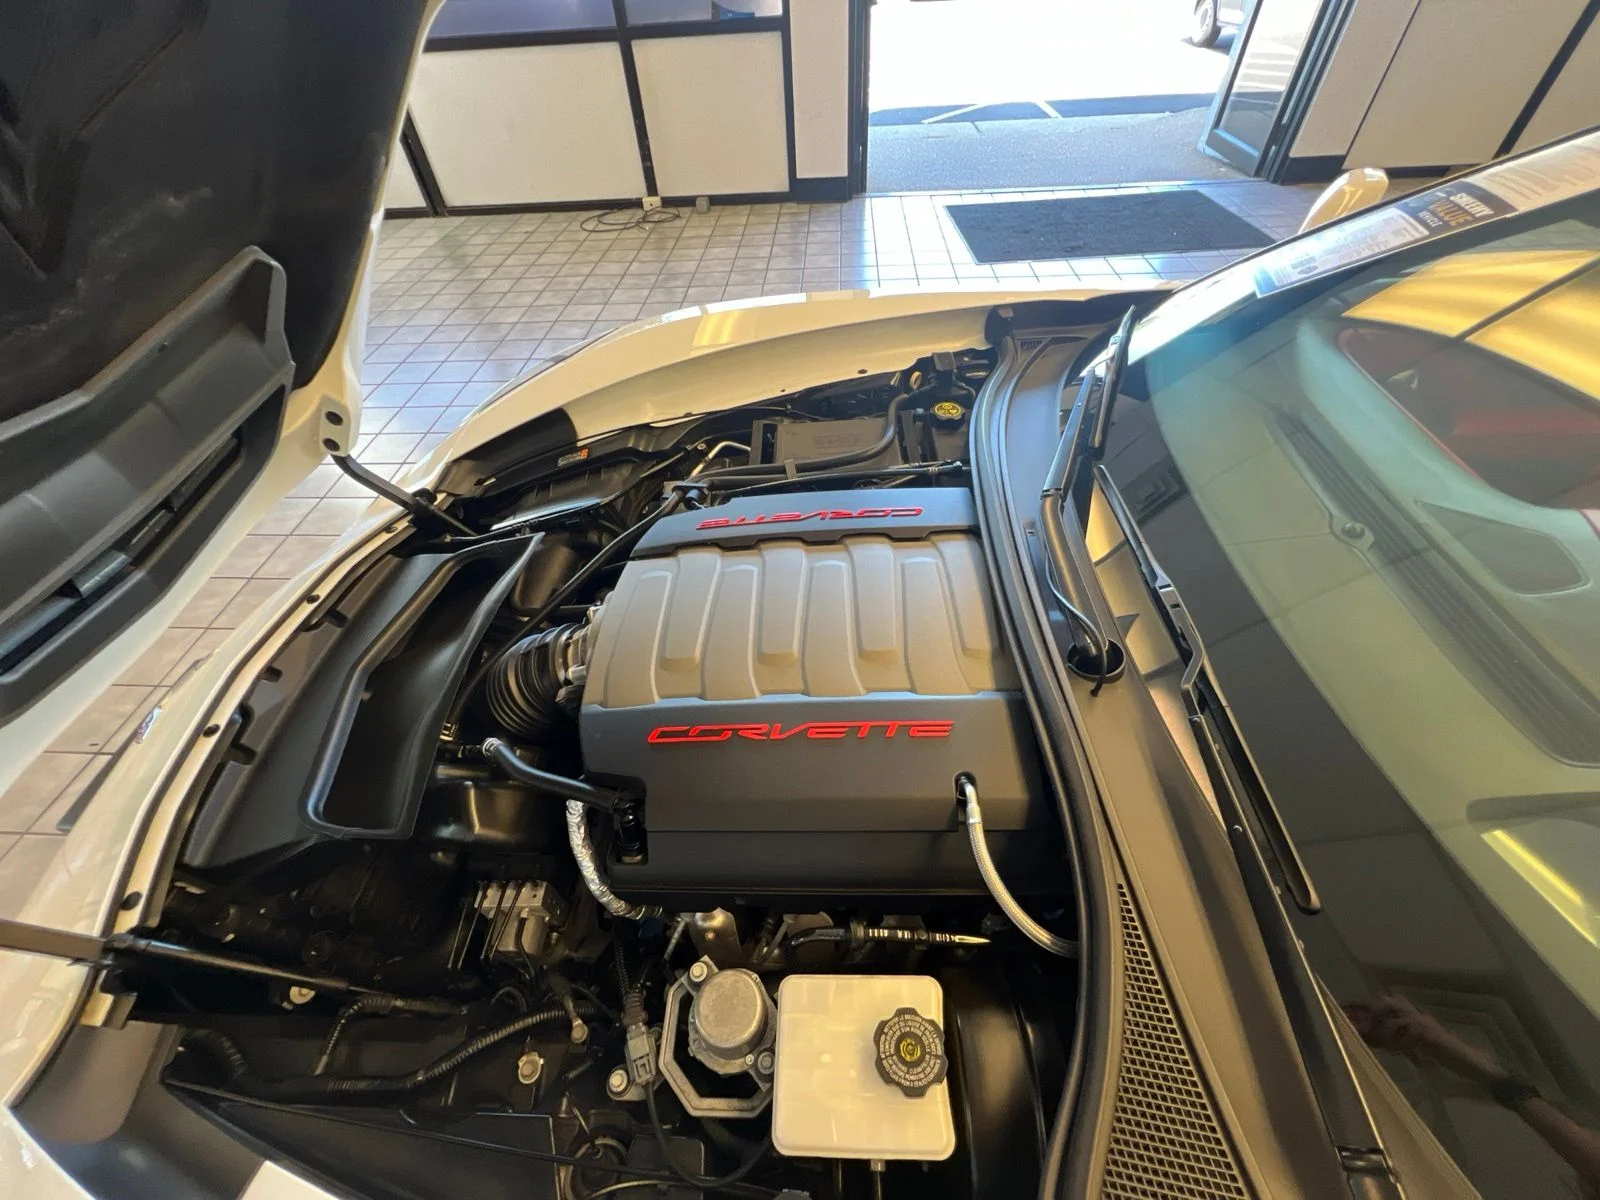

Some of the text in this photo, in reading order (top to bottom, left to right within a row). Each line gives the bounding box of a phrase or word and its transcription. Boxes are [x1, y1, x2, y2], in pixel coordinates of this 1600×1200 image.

[1428, 200, 1474, 226] VALUE
[1449, 192, 1494, 218] SHEEHY
[696, 507, 923, 530] CORVETTE
[648, 720, 954, 742] CORVETTE
